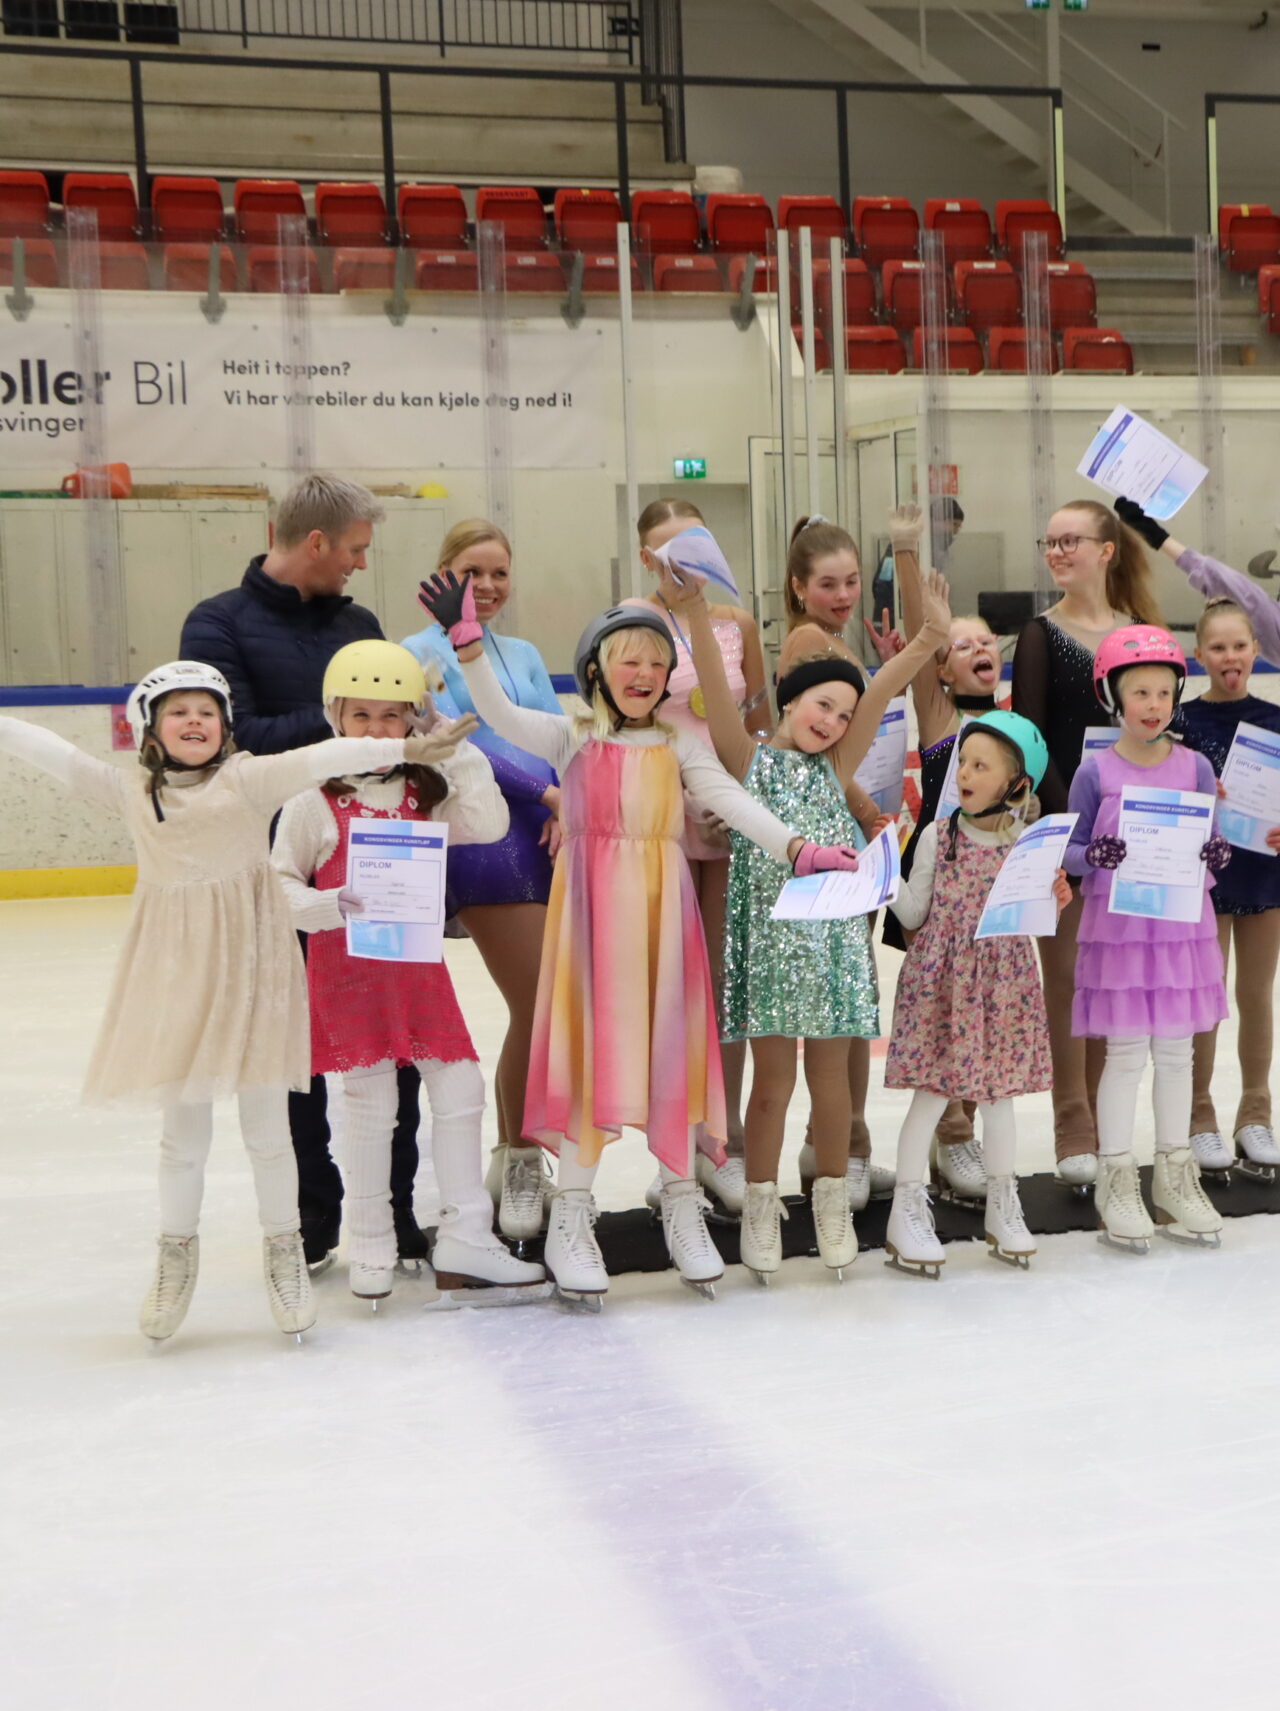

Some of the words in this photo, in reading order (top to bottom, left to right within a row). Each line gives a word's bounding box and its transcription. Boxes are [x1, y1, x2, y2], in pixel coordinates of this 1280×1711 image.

[223, 359, 260, 376] Heit
[265, 359, 270, 376] i
[275, 361, 351, 380] toppen?
[134, 359, 187, 406] Bil
[224, 389, 241, 406] Vi
[247, 389, 279, 406] har
[283, 391, 368, 407] vrebiler
[373, 391, 396, 407] du
[401, 391, 434, 407] kan
[439, 391, 480, 412] kjøle
[525, 392, 557, 408] ned
[562, 392, 573, 408] i!
[360, 861, 391, 869] DIPLOM
